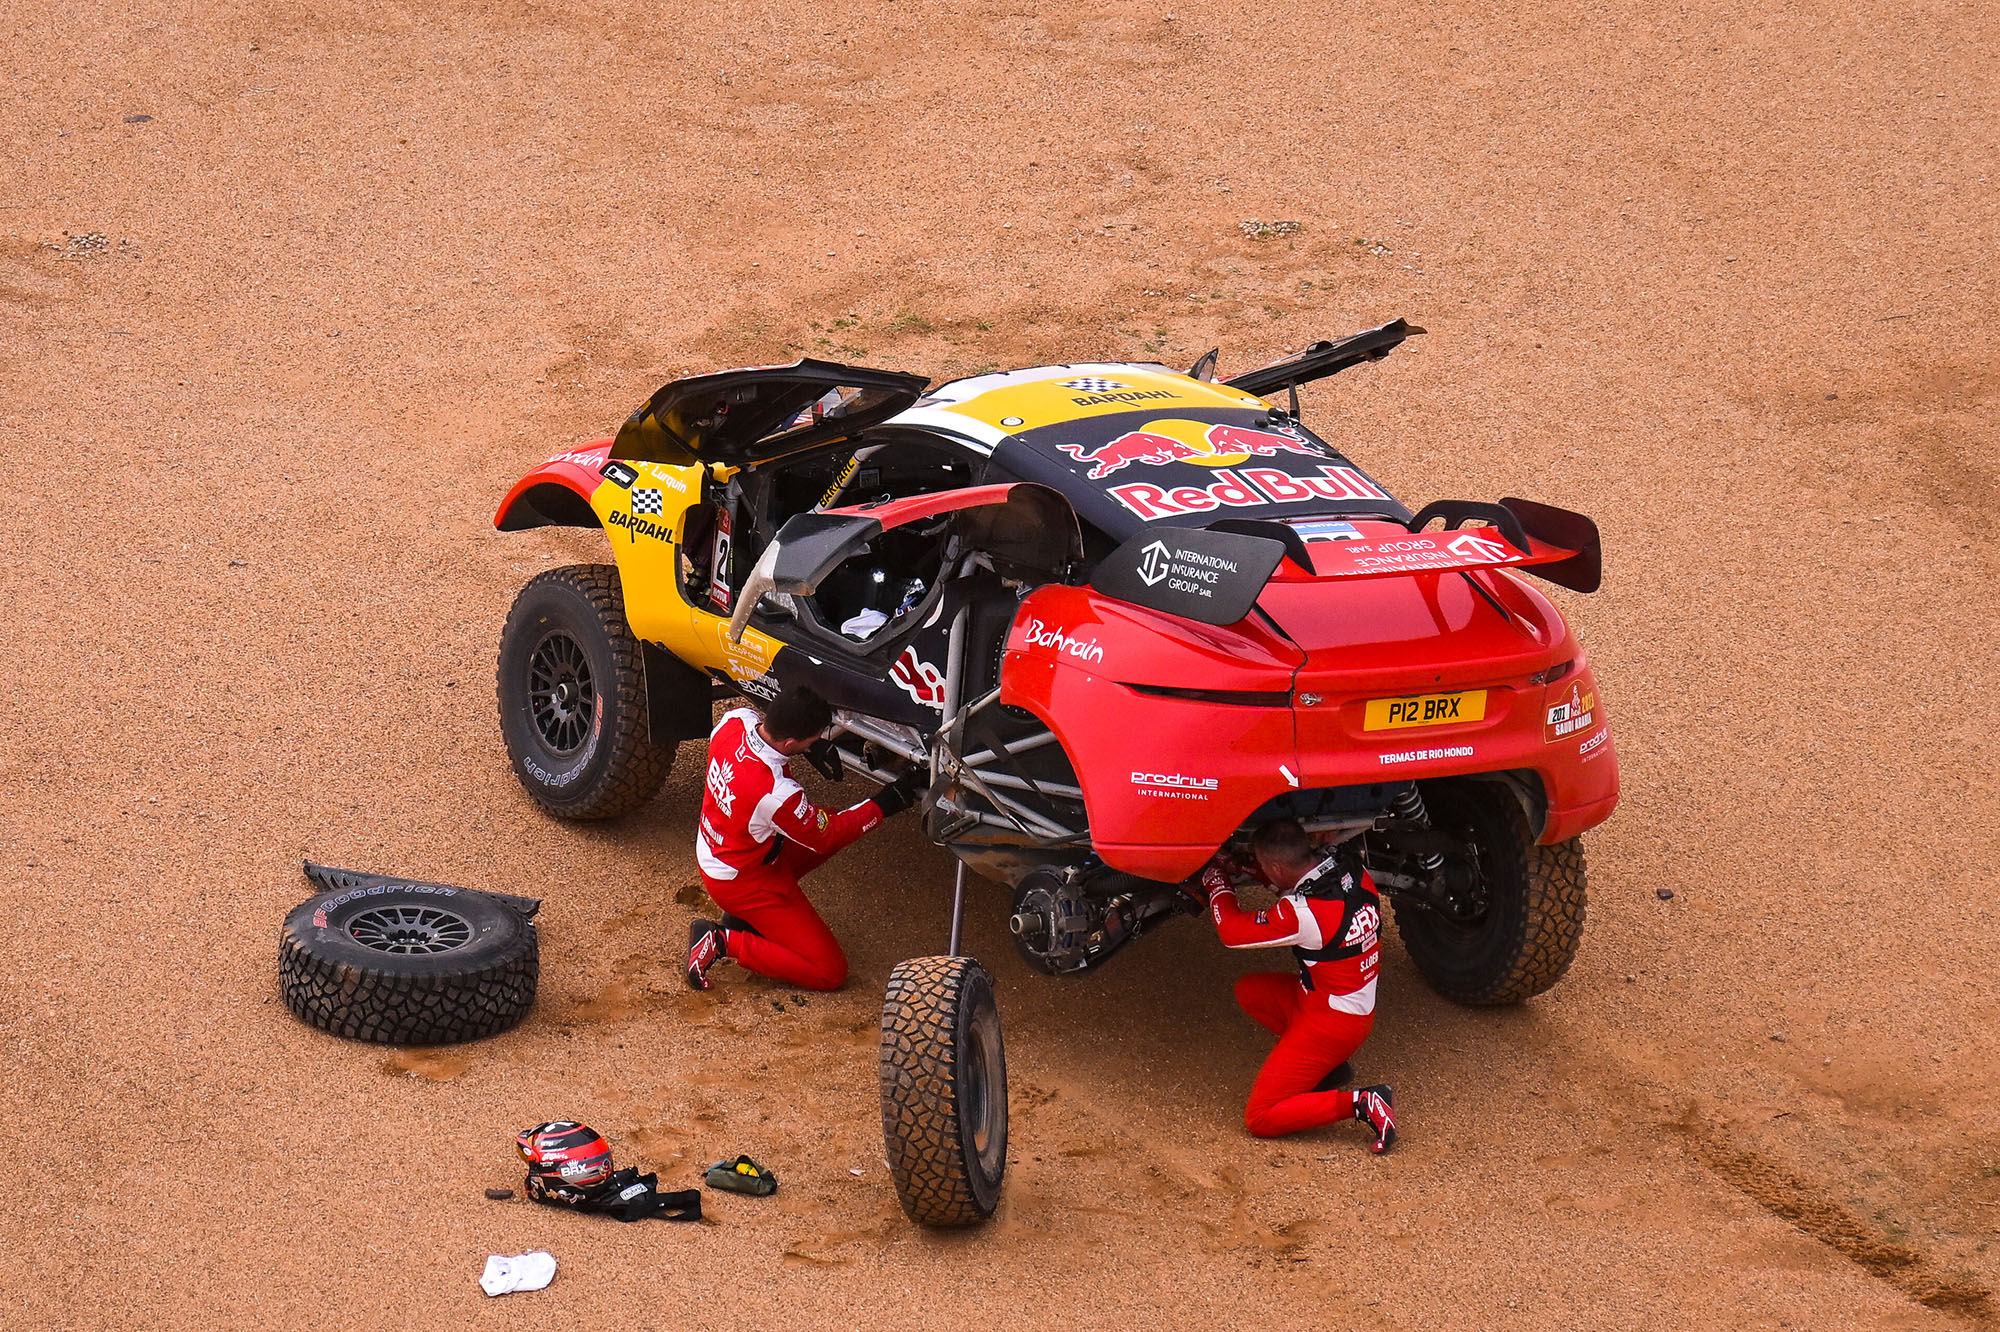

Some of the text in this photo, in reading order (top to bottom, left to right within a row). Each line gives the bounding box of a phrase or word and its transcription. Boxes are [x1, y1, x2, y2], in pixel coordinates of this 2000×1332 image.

[1072, 390, 1183, 406] BARDAHL
[651, 465, 687, 494] Lurquin
[1107, 465, 1393, 521] Red Bull
[608, 510, 675, 544] BARDAHL
[1345, 539, 1436, 554] GROUP SARL
[1175, 548, 1238, 573] INTERNATIONAL
[1354, 551, 1449, 567] INSURANCE
[1171, 563, 1219, 584] INSURANCE
[1168, 578, 1212, 598] GROUP SARL
[1024, 619, 1104, 664] Bahrain
[1389, 697, 1461, 723] P12 BRX
[1552, 707, 1566, 723] 201
[1555, 719, 1574, 736] SAUDI
[1379, 752, 1416, 764] TERMAS
[1416, 750, 1428, 761] DE
[1444, 746, 1473, 758] HONDO
[708, 757, 736, 812] BRX
[1131, 772, 1218, 789] prodrive
[1138, 789, 1208, 801] INTERNATIONAL
[1345, 903, 1380, 942] BRX
[560, 1163, 587, 1177] BRX
